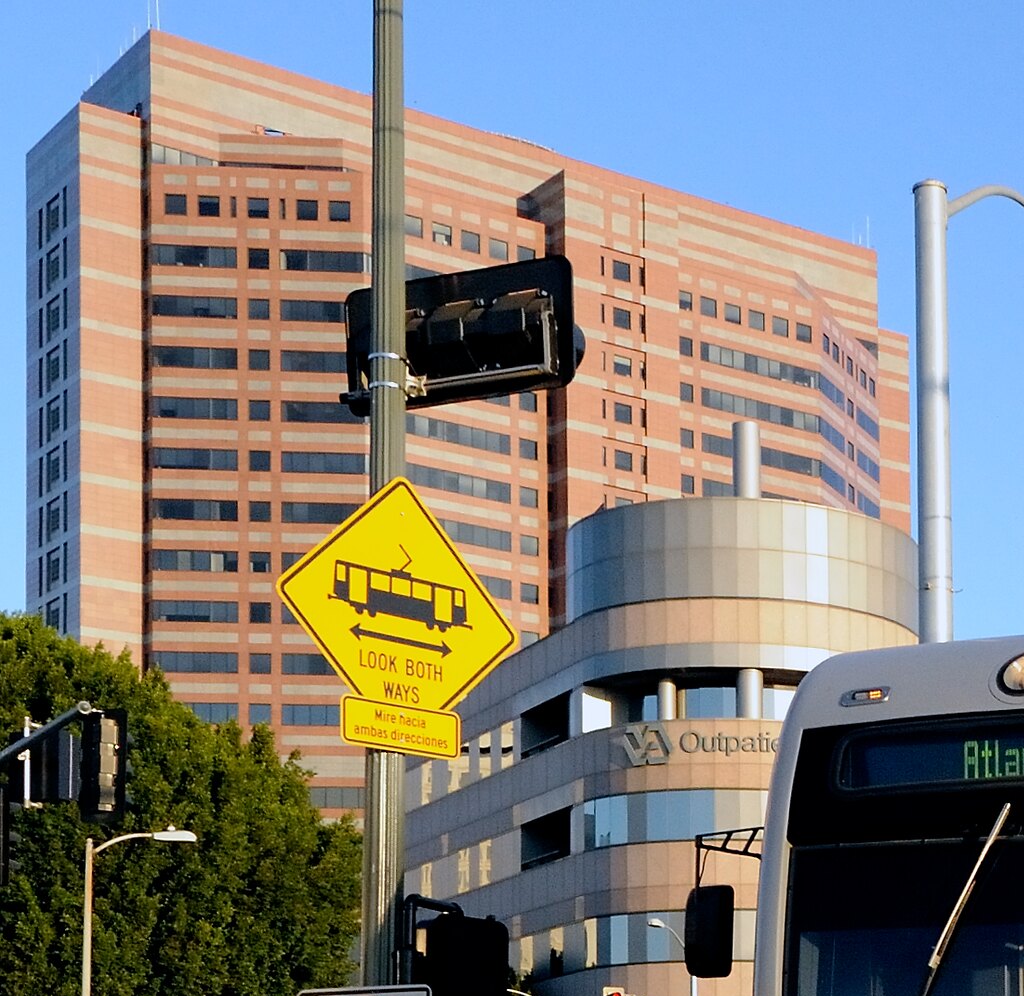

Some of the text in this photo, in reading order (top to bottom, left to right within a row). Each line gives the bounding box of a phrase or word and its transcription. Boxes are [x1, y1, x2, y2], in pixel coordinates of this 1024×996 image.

[359, 649, 443, 682] LOOK BOTH
[383, 681, 420, 704] WAYS
[375, 709, 426, 728] Mire hacia
[354, 725, 448, 749] ambas direcciones
